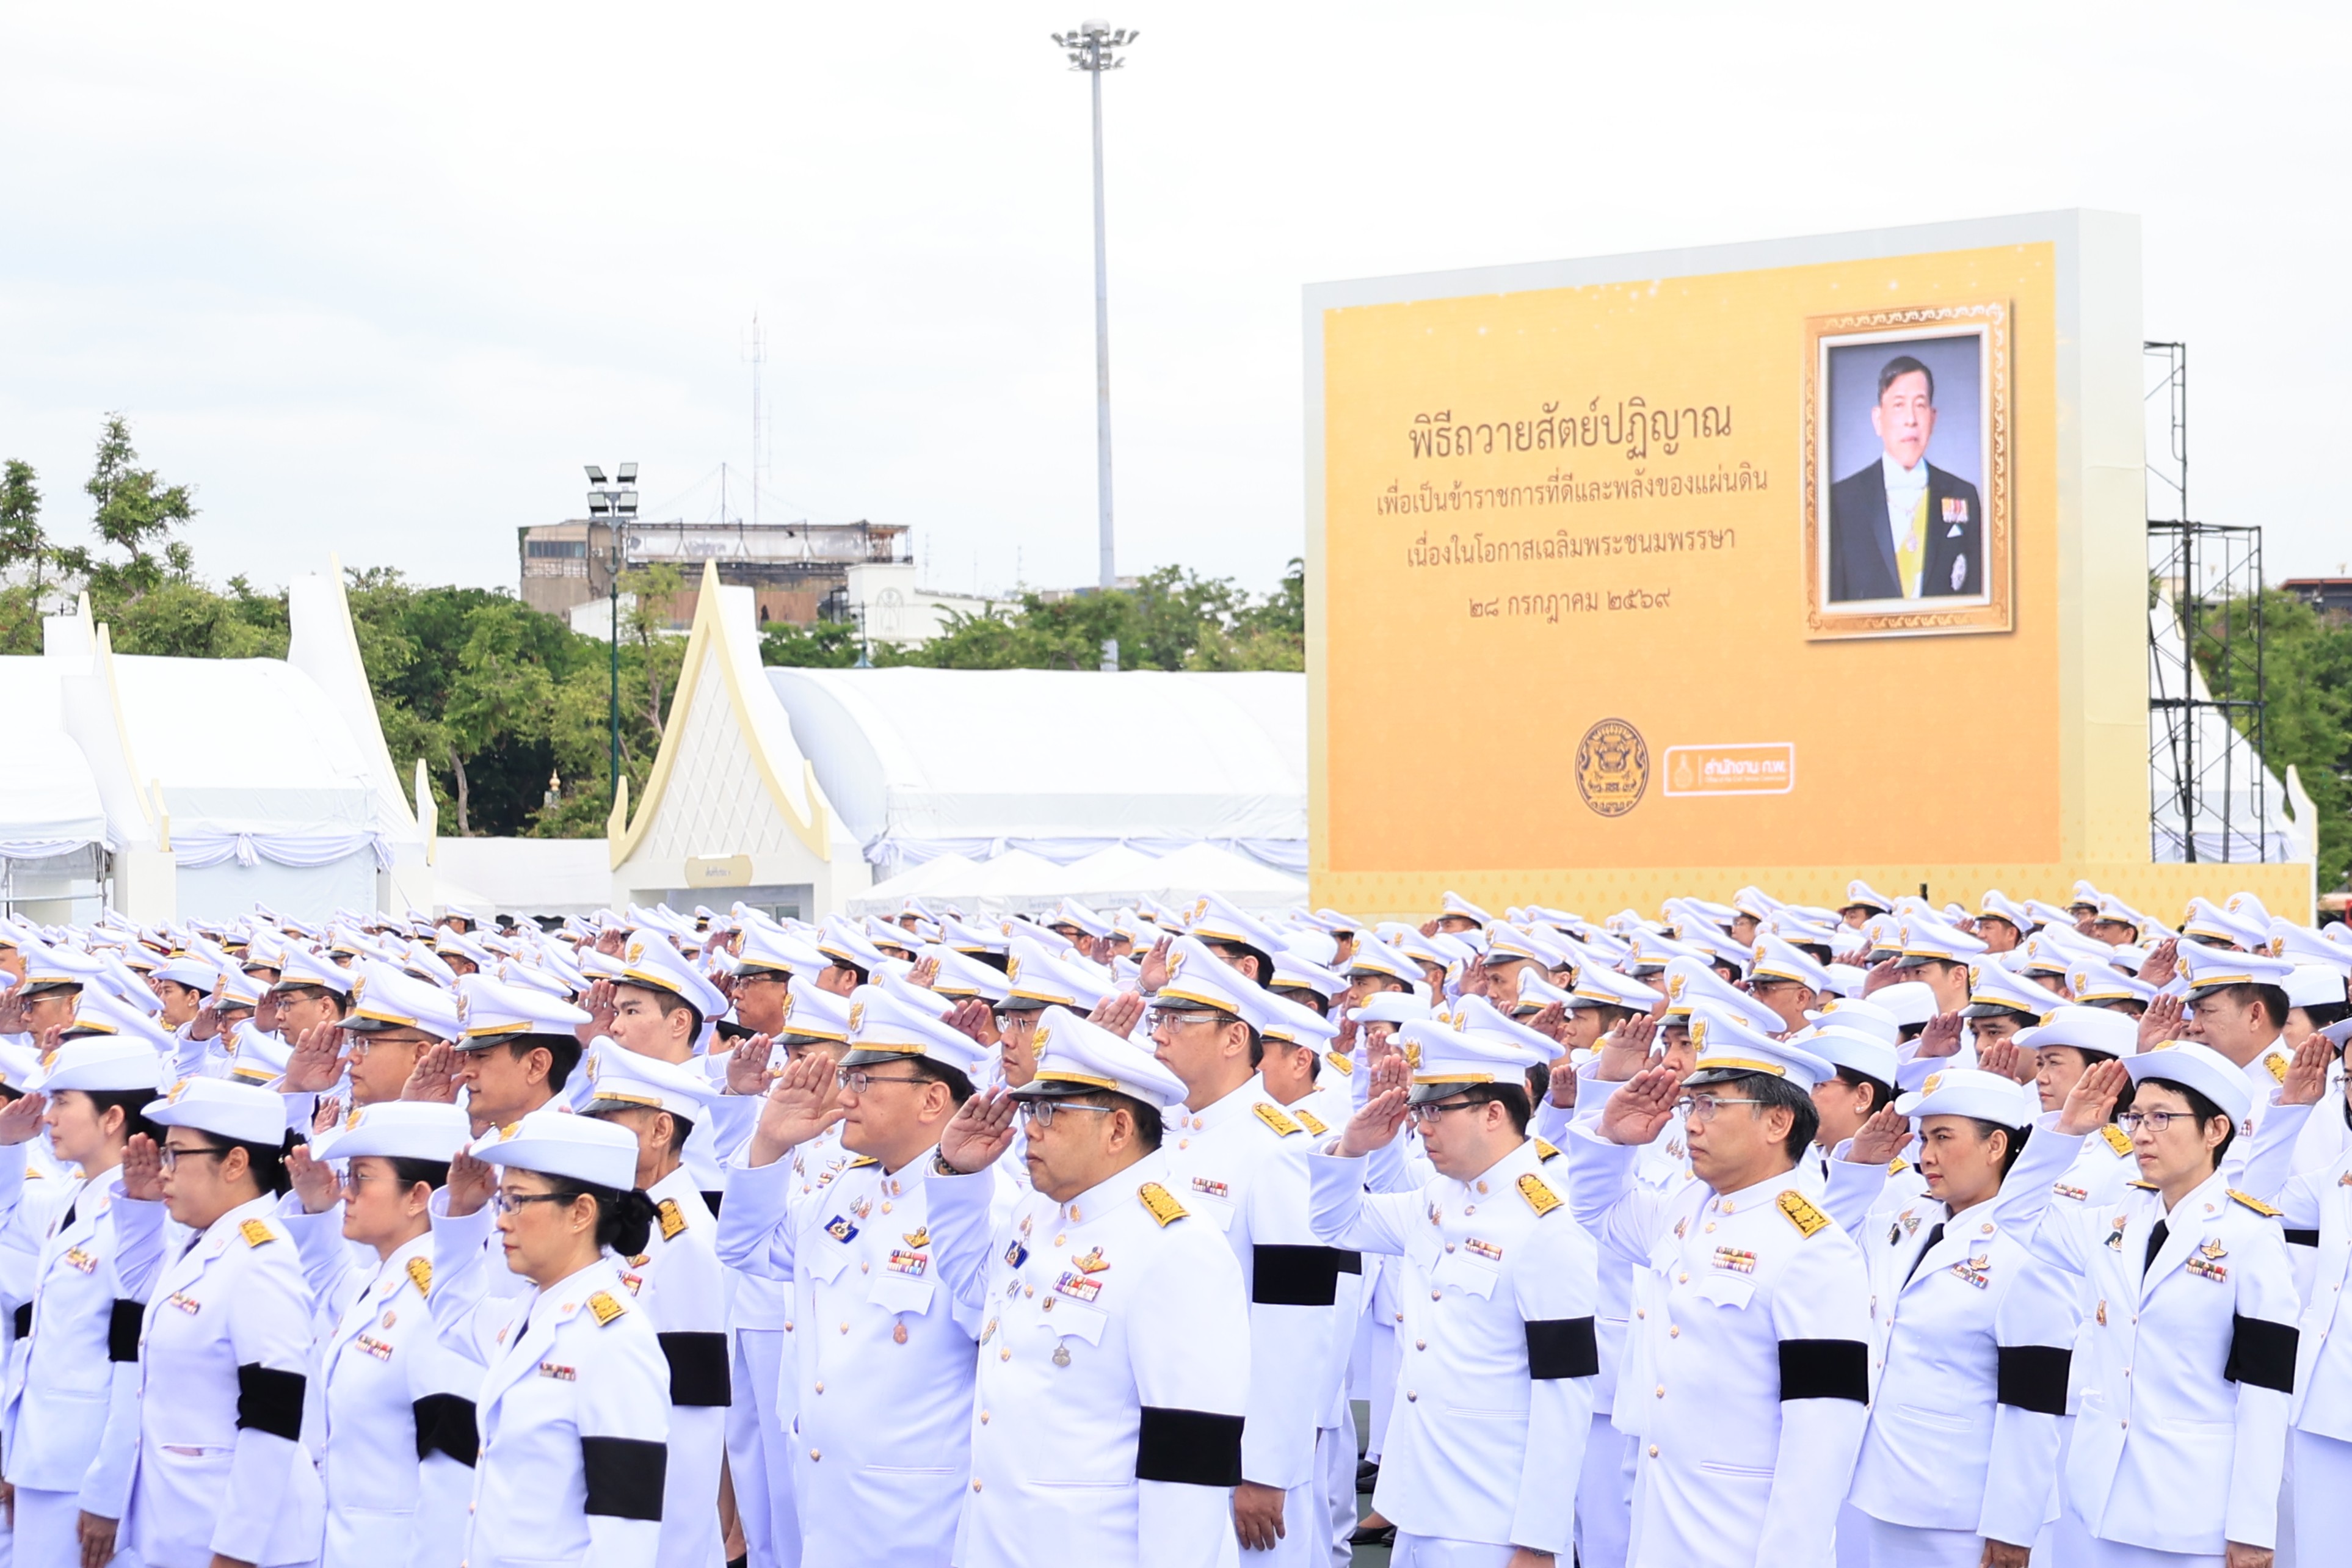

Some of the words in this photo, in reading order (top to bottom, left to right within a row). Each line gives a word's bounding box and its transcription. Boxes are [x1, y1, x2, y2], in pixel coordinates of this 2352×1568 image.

[1409, 396, 1731, 459] พิธีถวายสัตย์ปฏิญาณ
[1377, 462, 1767, 515] เพื่อเป็นข้าราชการที่ดีและพลังของแผ่นดิน
[1407, 529, 1734, 567] เนื่องในโอกาสเฉลิมพระชนมพรรษา
[1469, 598, 1498, 617] ๒๘
[1508, 592, 1598, 623] กรกฎาคม
[1607, 588, 1671, 610] ๒๕๖๙
[1704, 758, 1759, 774] สำนักงาน
